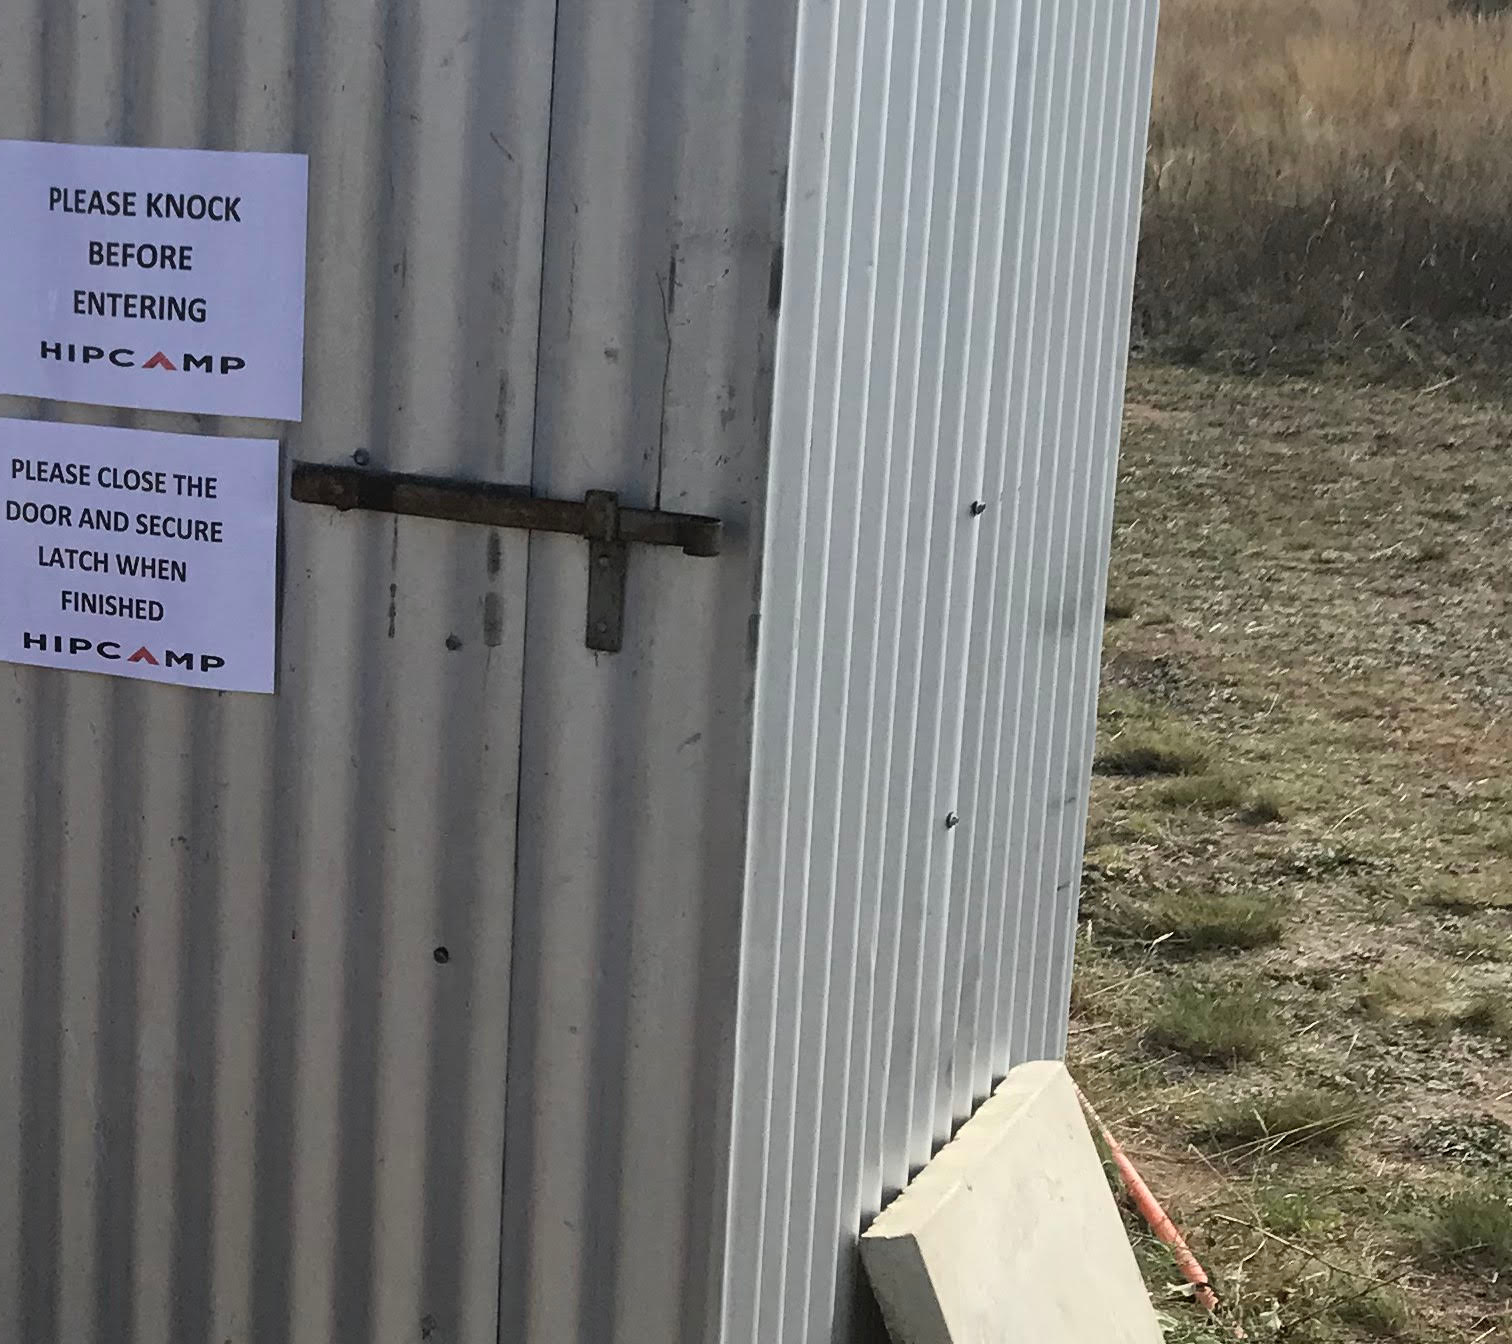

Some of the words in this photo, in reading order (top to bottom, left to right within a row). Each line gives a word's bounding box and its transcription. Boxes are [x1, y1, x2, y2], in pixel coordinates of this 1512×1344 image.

[50, 187, 136, 216] PLEASE
[147, 192, 241, 222] KNOCK
[89, 241, 192, 270] BEFORE
[74, 290, 206, 323] ENTERING
[41, 341, 246, 374] HIPCAMP
[12, 459, 90, 486] PLEASE
[98, 467, 166, 494] CLOSE
[173, 474, 217, 498] THE
[6, 500, 72, 527] DOOR
[79, 508, 129, 532] AND
[136, 514, 223, 542] SECURE
[39, 546, 108, 573] LATCH
[116, 554, 186, 582] WHEN
[62, 590, 164, 621] FINISHED
[24, 632, 225, 672] HIPCAMP
